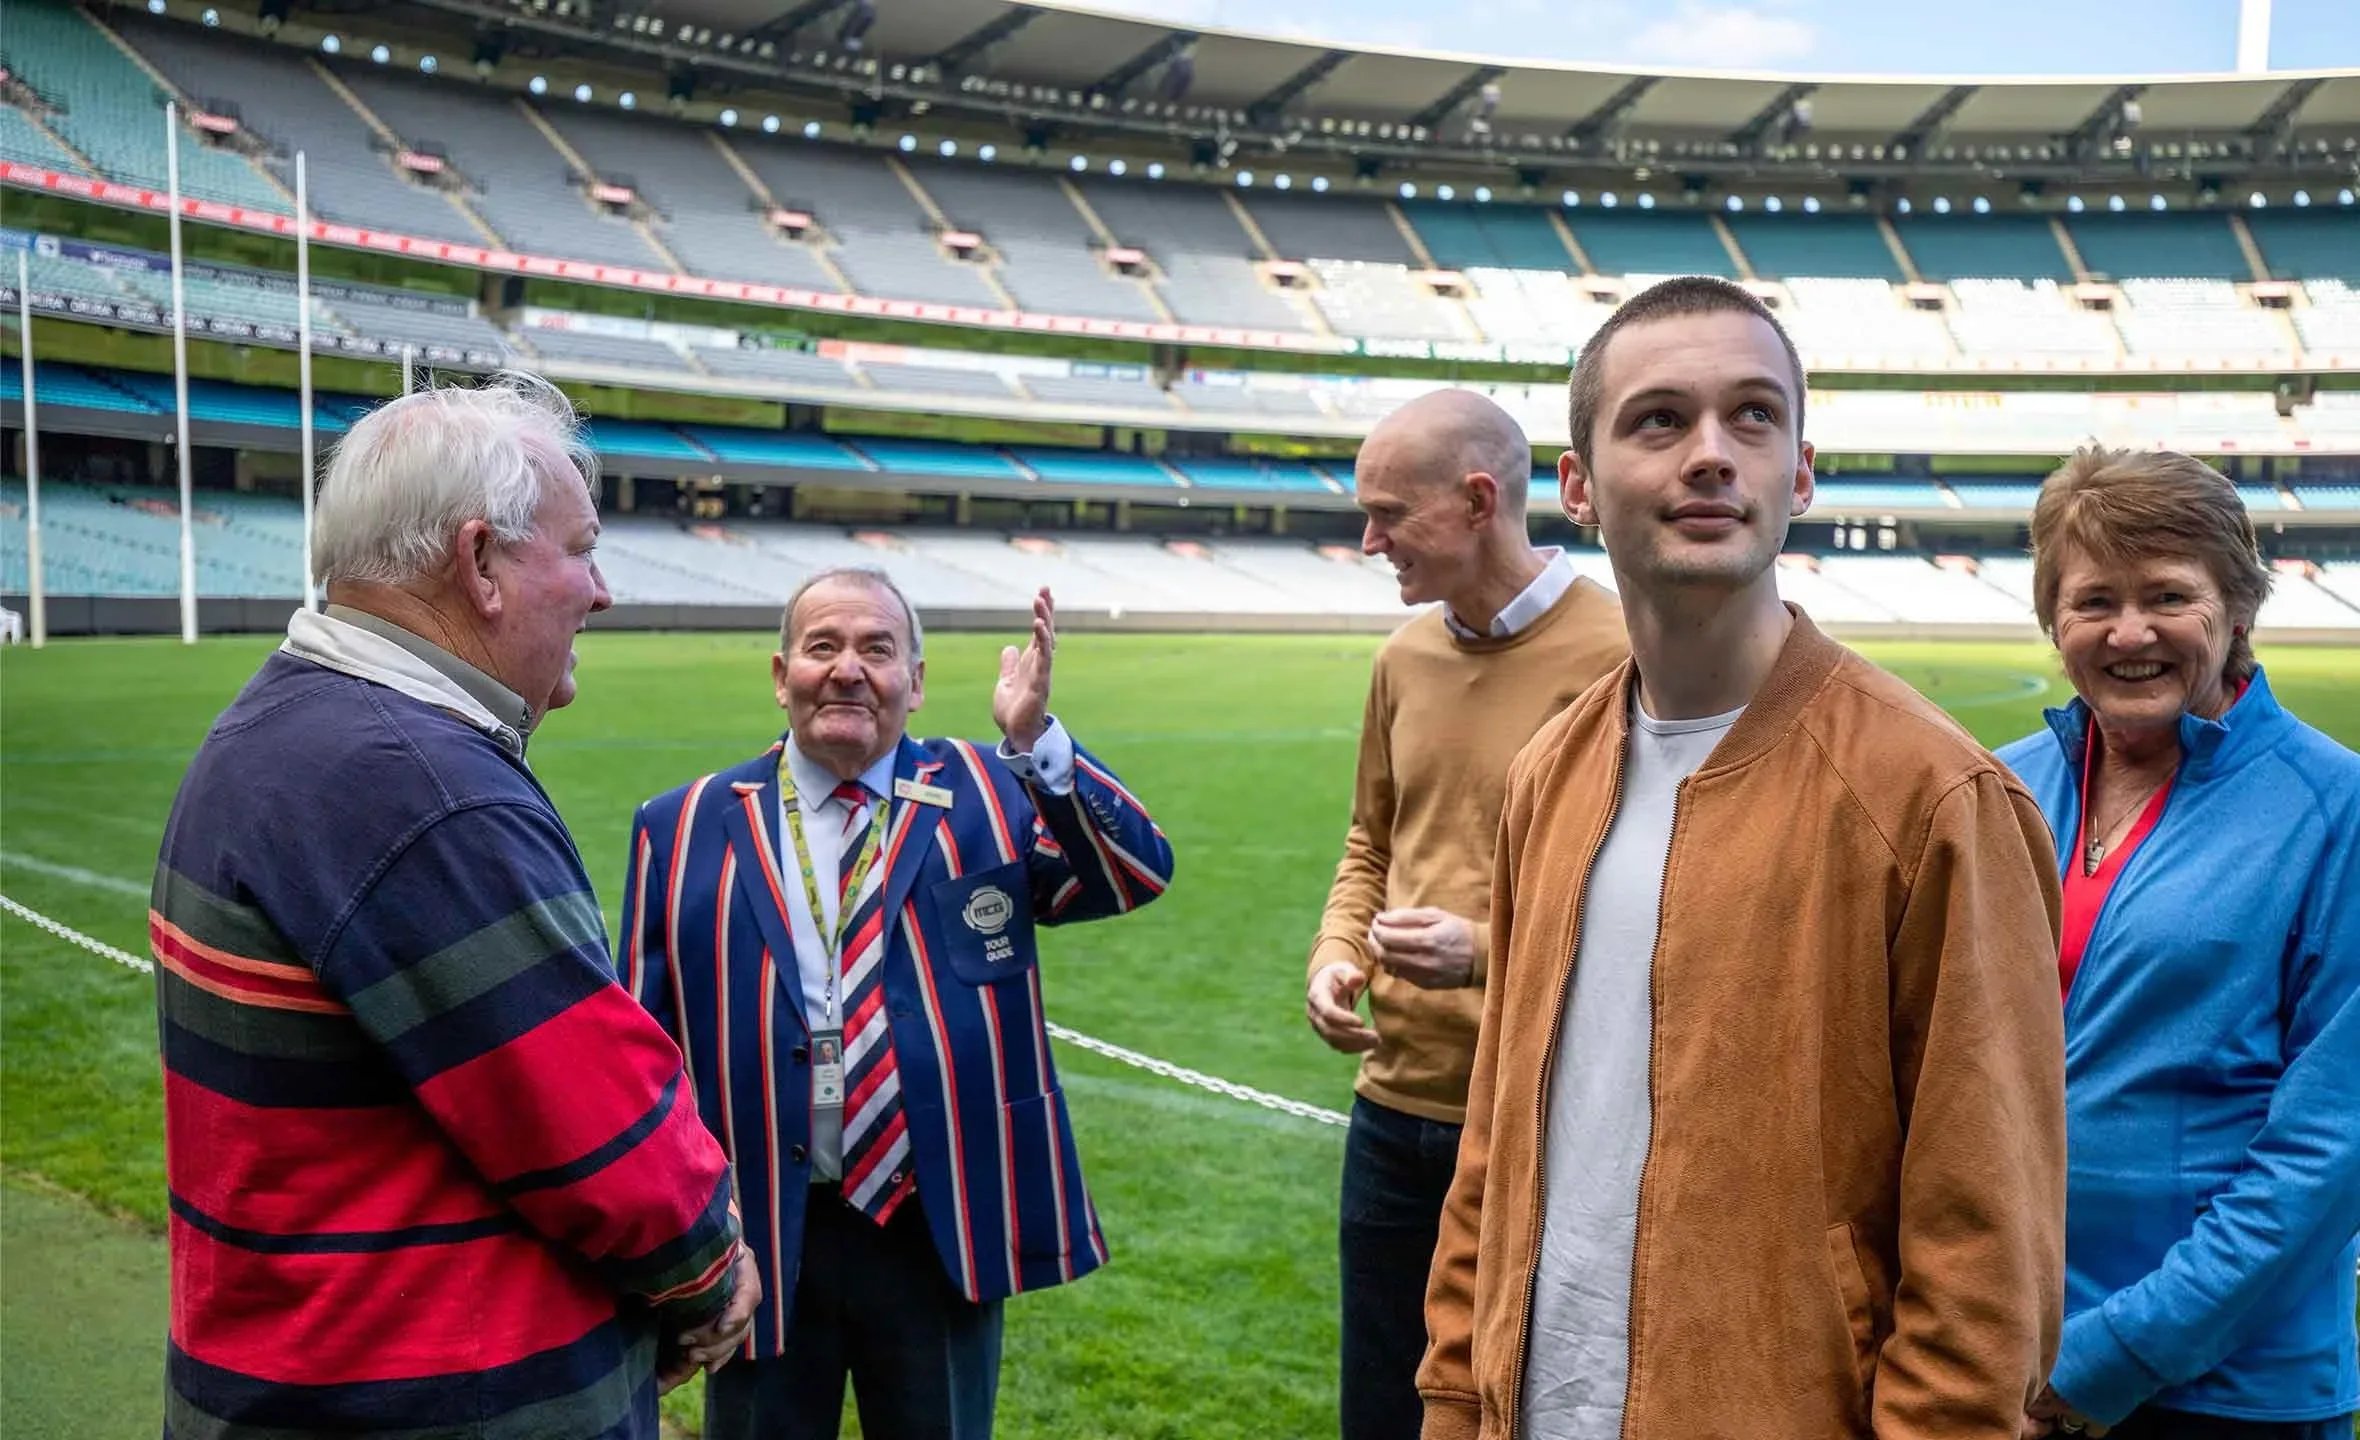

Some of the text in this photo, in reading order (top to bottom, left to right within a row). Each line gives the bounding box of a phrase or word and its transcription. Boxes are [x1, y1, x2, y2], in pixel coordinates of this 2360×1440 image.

[974, 903, 1004, 918] MCG
[984, 936, 1009, 950] TOUR
[986, 947, 1014, 961] GUIDE
